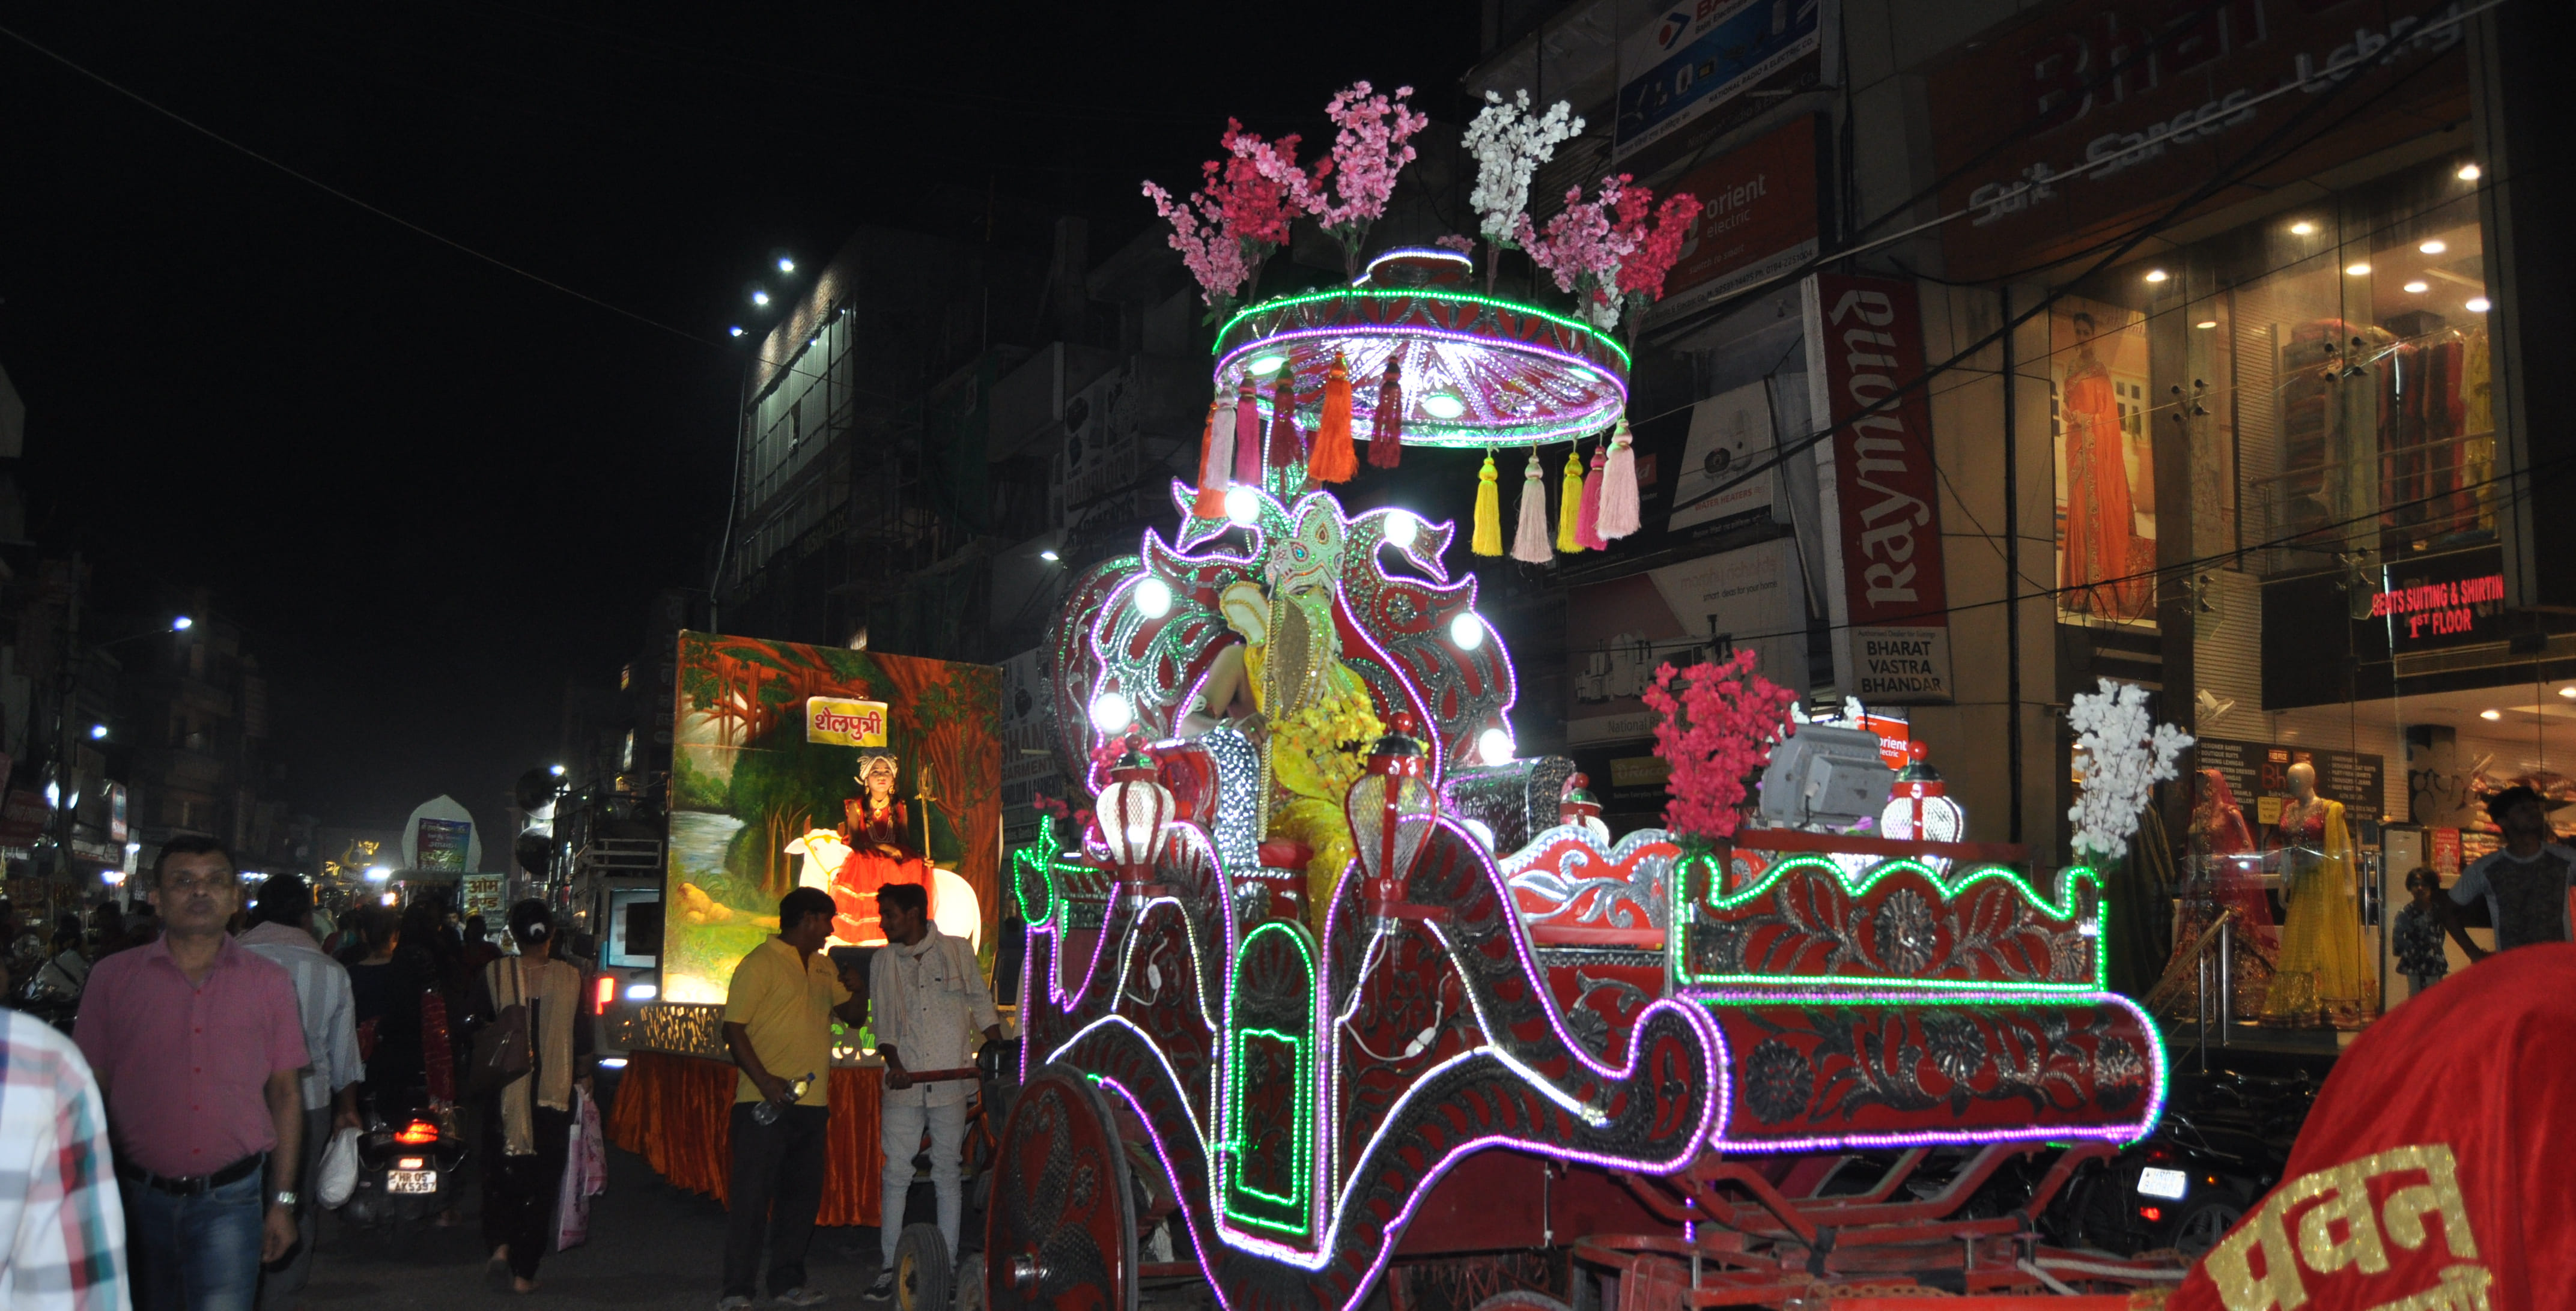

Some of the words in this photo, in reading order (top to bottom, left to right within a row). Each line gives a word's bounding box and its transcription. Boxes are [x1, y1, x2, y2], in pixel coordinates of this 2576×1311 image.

[1742, 68, 1761, 84] RADIO
[1769, 46, 1800, 69] ELECTRIC
[1970, 162, 2057, 226] Suit
[2086, 88, 2256, 180] Sarees
[1707, 174, 1767, 220] orient
[1707, 209, 1751, 238] electric
[1695, 498, 1719, 512] WATER
[1720, 487, 1753, 503] HEATERS
[1760, 581, 1778, 590] home
[2372, 589, 2405, 616] GENTS
[2407, 582, 2448, 611] SUITING
[2450, 581, 2459, 605] &
[2432, 608, 2473, 635] FLOOR
[1867, 641, 1931, 656] BHARAT
[1868, 659, 1932, 674] VASTRA
[1861, 677, 1942, 693] BHANDAR
[1608, 716, 1648, 733] National
[1880, 749, 1899, 758] lectric
